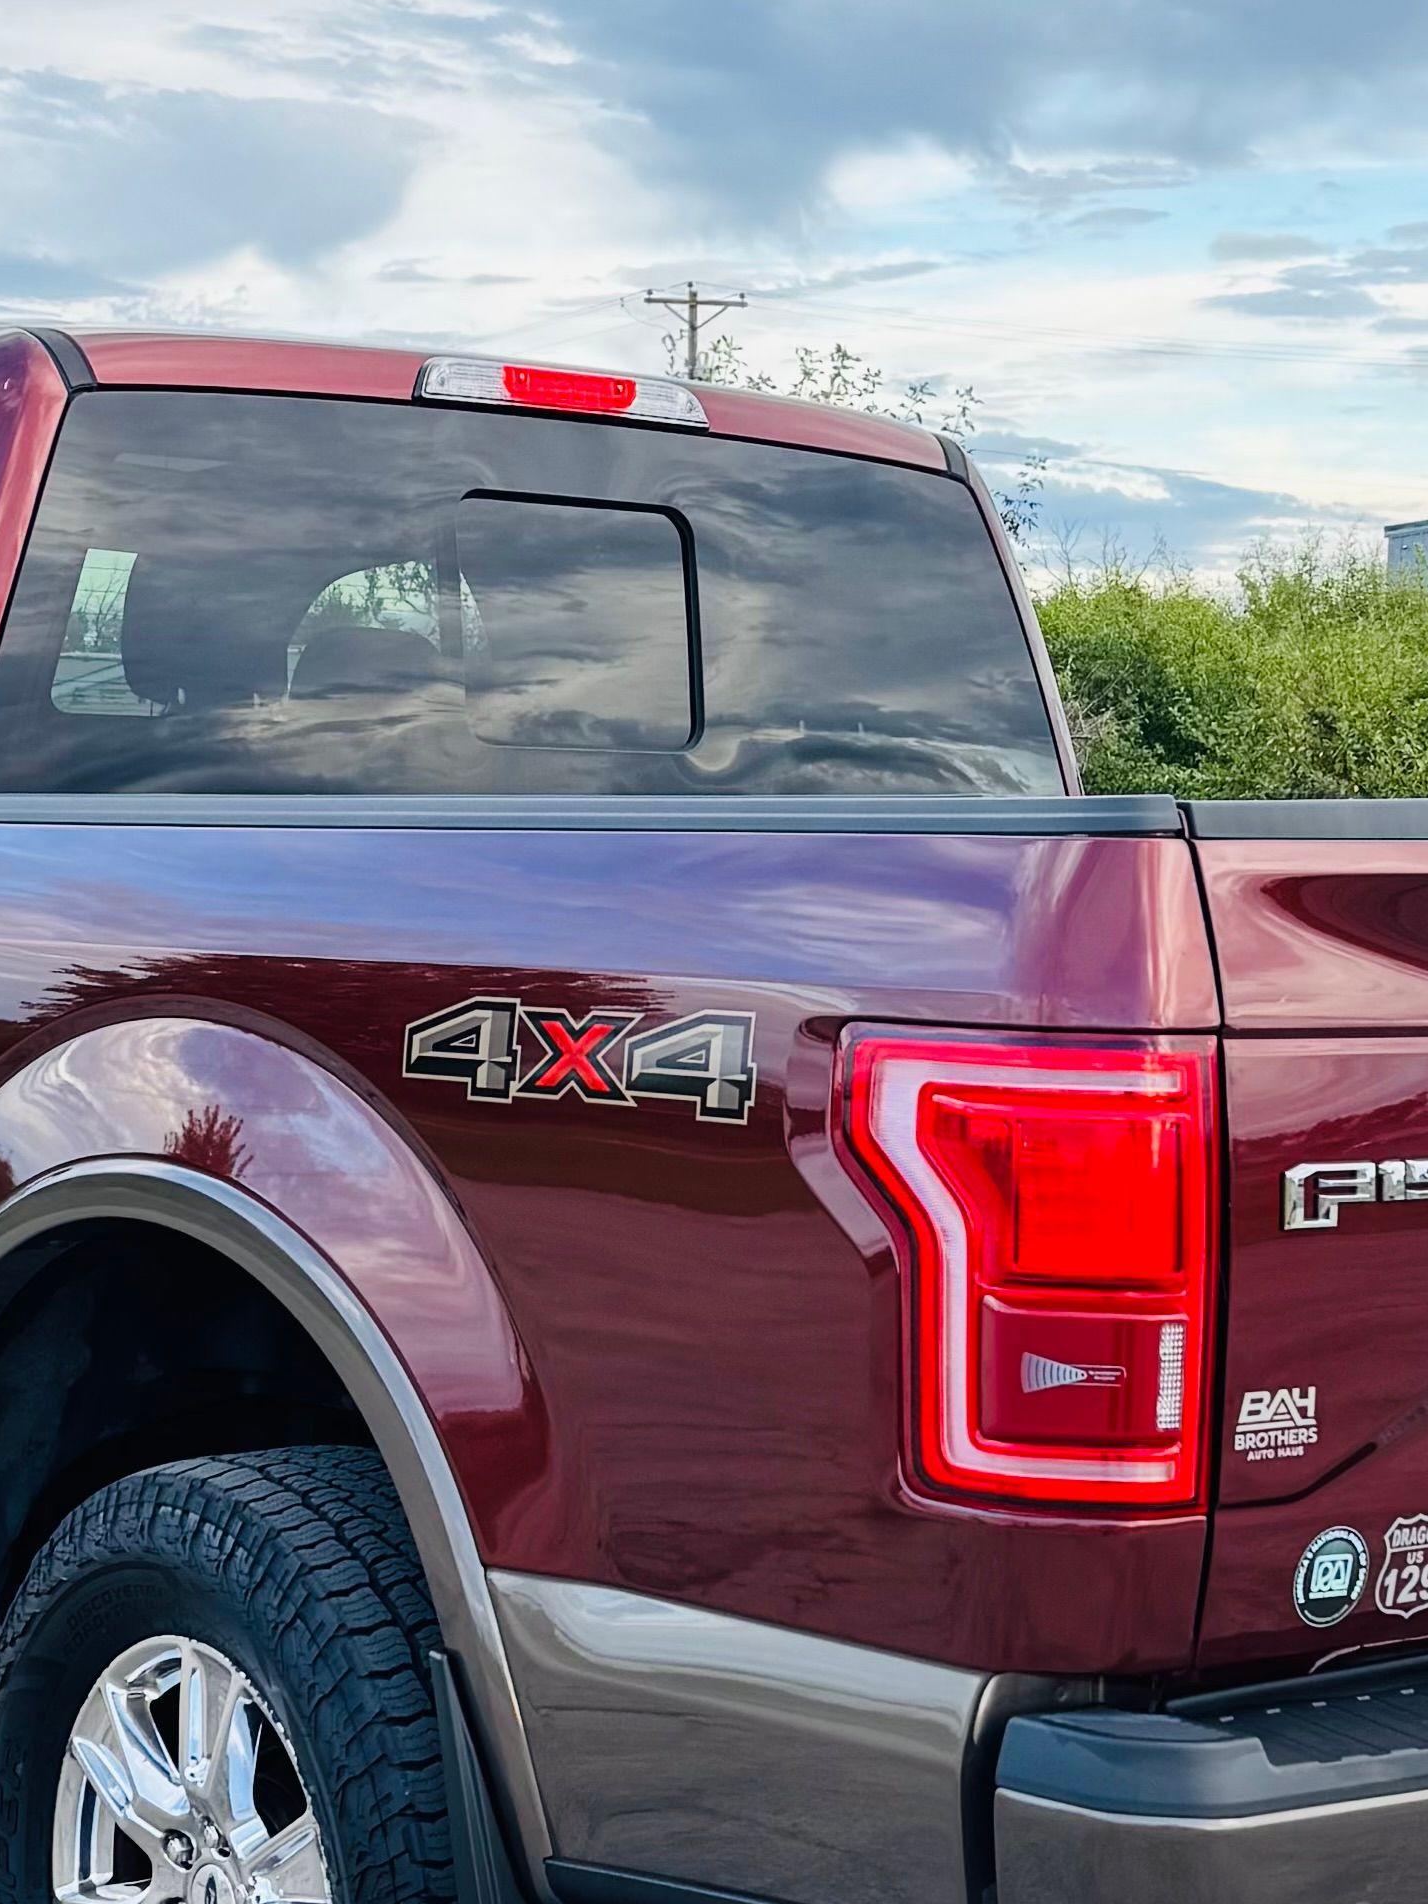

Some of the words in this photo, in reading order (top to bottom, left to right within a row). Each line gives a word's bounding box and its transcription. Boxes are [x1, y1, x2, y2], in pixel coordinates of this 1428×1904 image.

[1234, 1427, 1318, 1451] BROTHERS
[1247, 1448, 1275, 1462] AUTO
[1277, 1446, 1304, 1458] HAUS
[1406, 1550, 1424, 1565] US
